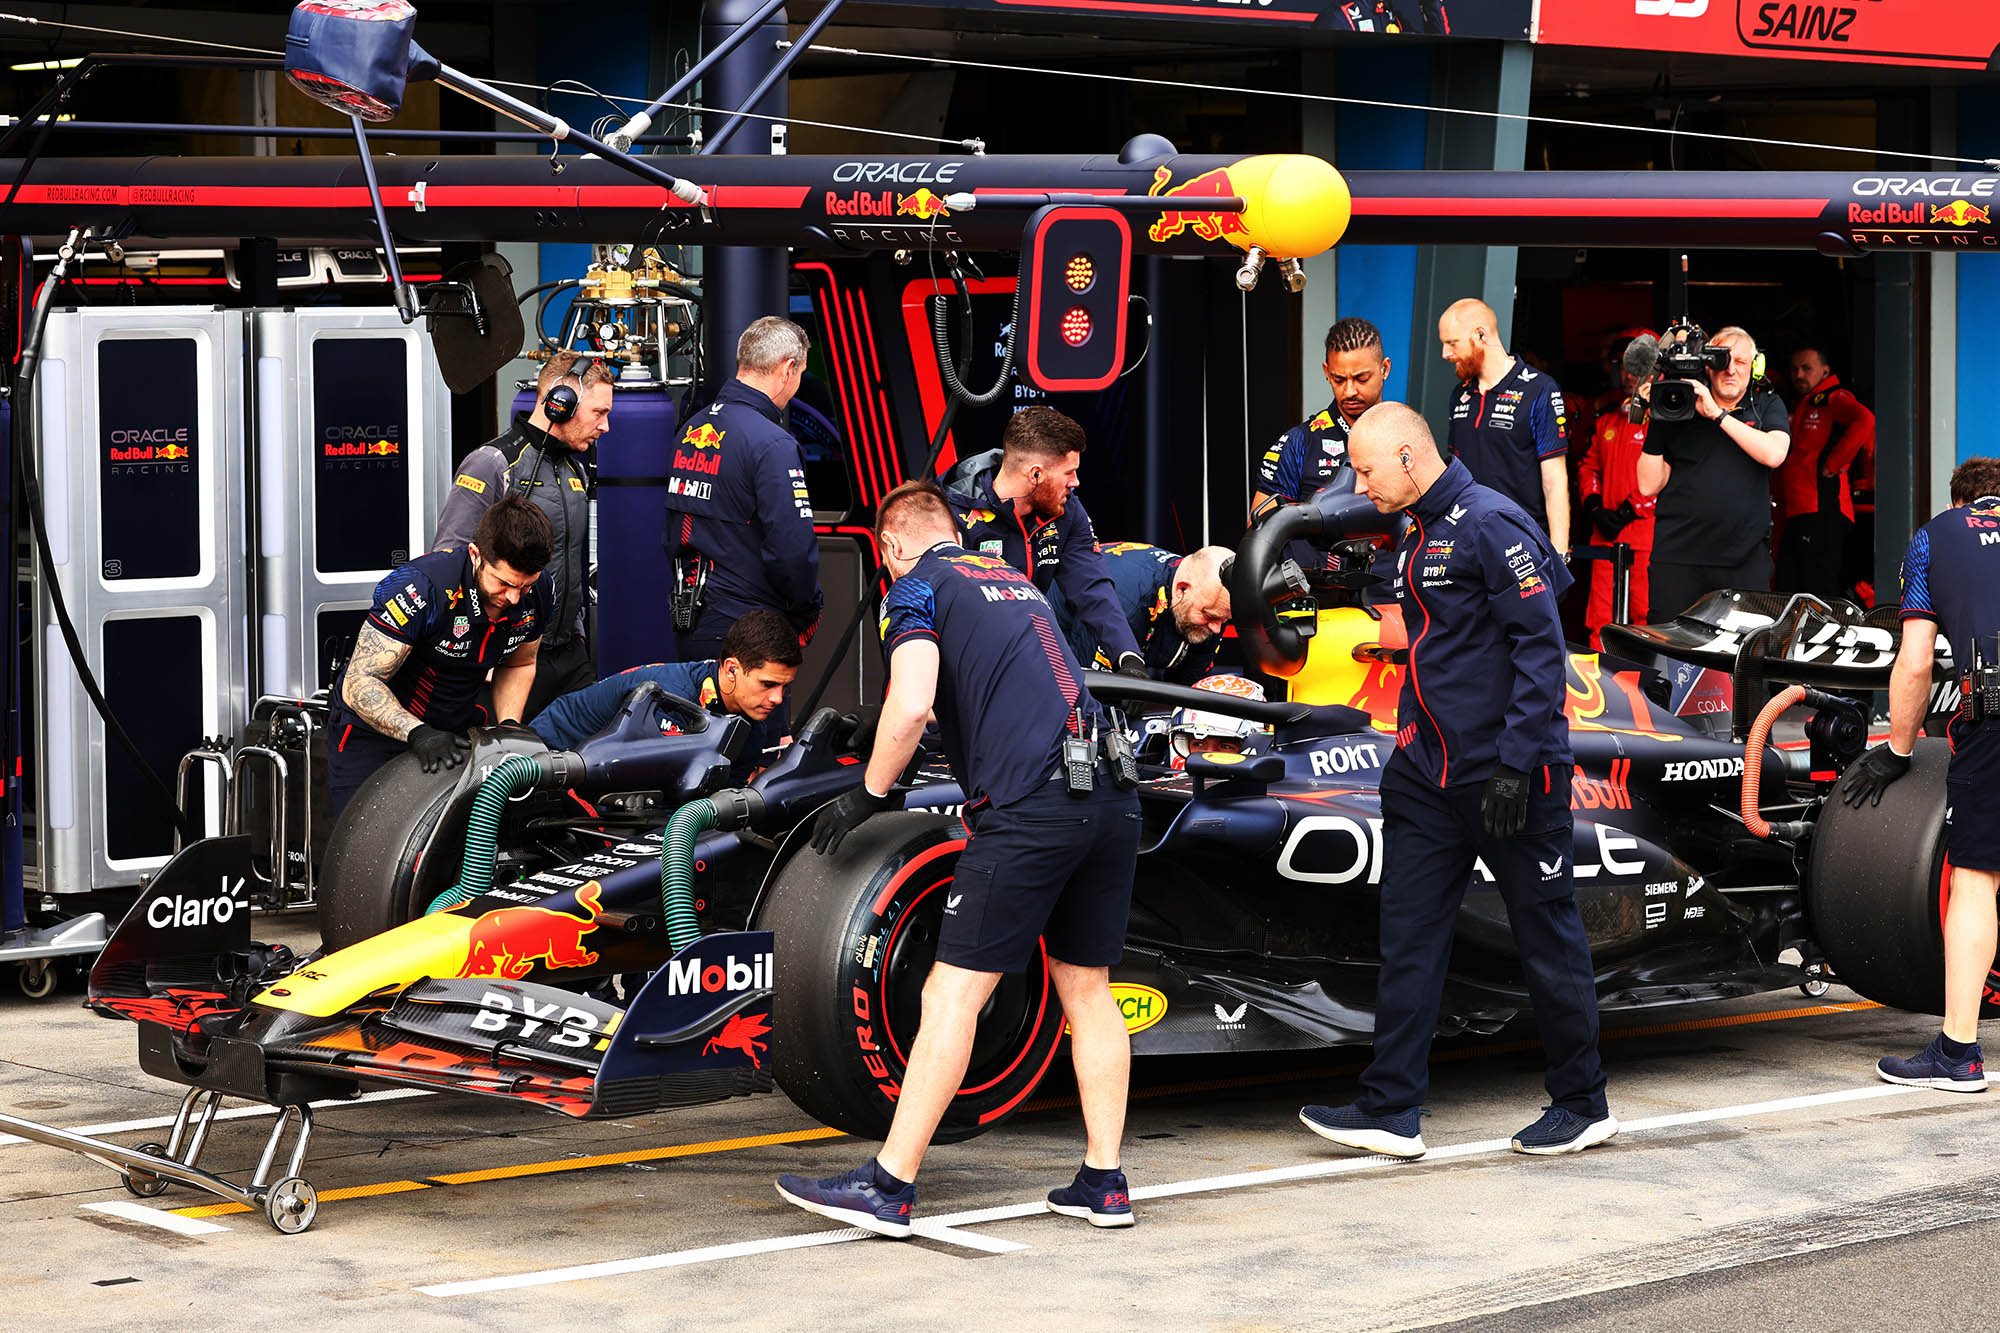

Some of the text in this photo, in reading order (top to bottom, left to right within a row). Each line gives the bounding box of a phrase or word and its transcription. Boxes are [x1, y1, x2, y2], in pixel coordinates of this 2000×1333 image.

[1753, 4, 1857, 41] SAINZ
[833, 162, 963, 183] ORACLE
[47, 188, 118, 201] REDBULLRACING.COM
[1852, 178, 2000, 196] ORACLE
[833, 229, 963, 242] RACING
[1852, 234, 1998, 246] RACING
[337, 251, 374, 260] ORACLE
[995, 342, 1008, 358] Re
[325, 425, 399, 439] ORACLE
[1337, 416, 1351, 435] zoo
[110, 428, 188, 444] ORACLE
[111, 464, 189, 475] RACING
[325, 460, 400, 470] RACING
[668, 476, 698, 498] Mobil
[391, 549, 408, 566] 2
[1038, 544, 1058, 559] YBIT
[104, 559, 122, 578] 3
[1422, 564, 1447, 577] BYBIT
[404, 583, 427, 610] Mobil
[469, 588, 482, 617] zoom
[980, 586, 1034, 603] Mobil
[395, 593, 417, 617] Claro
[434, 646, 469, 658] ORACLE
[439, 640, 464, 650] Mobil
[1697, 699, 1730, 713] COLA
[1308, 743, 1381, 777] ROKT
[1660, 757, 1745, 782] HONDA
[583, 853, 638, 868] zoom
[1644, 881, 1678, 896] SIEMENS
[147, 888, 240, 929] Claro
[667, 952, 774, 996] Mobil
[853, 986, 901, 1103] ZERO
